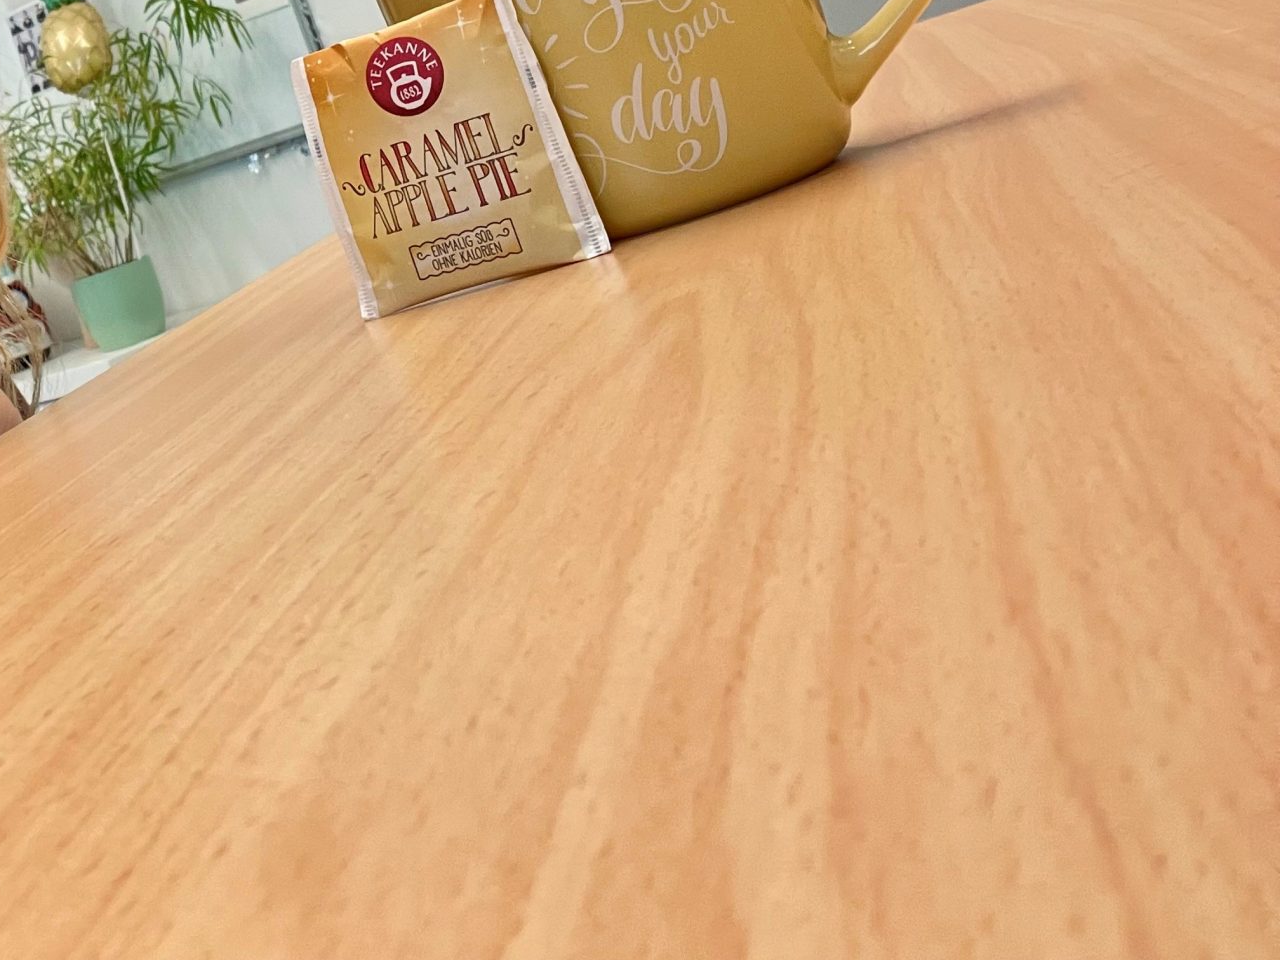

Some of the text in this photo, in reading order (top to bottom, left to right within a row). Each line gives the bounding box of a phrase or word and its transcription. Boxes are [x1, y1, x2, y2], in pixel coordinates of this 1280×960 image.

[370, 41, 439, 91] TEEKANNE
[646, 1, 736, 85] your
[399, 84, 422, 101] 1882
[610, 62, 729, 175] day
[358, 112, 515, 194] CARAMEL
[372, 152, 532, 239] APPLE PIE
[430, 235, 474, 258] EINMALIG
[431, 241, 504, 271] OHNE KALORIEN
